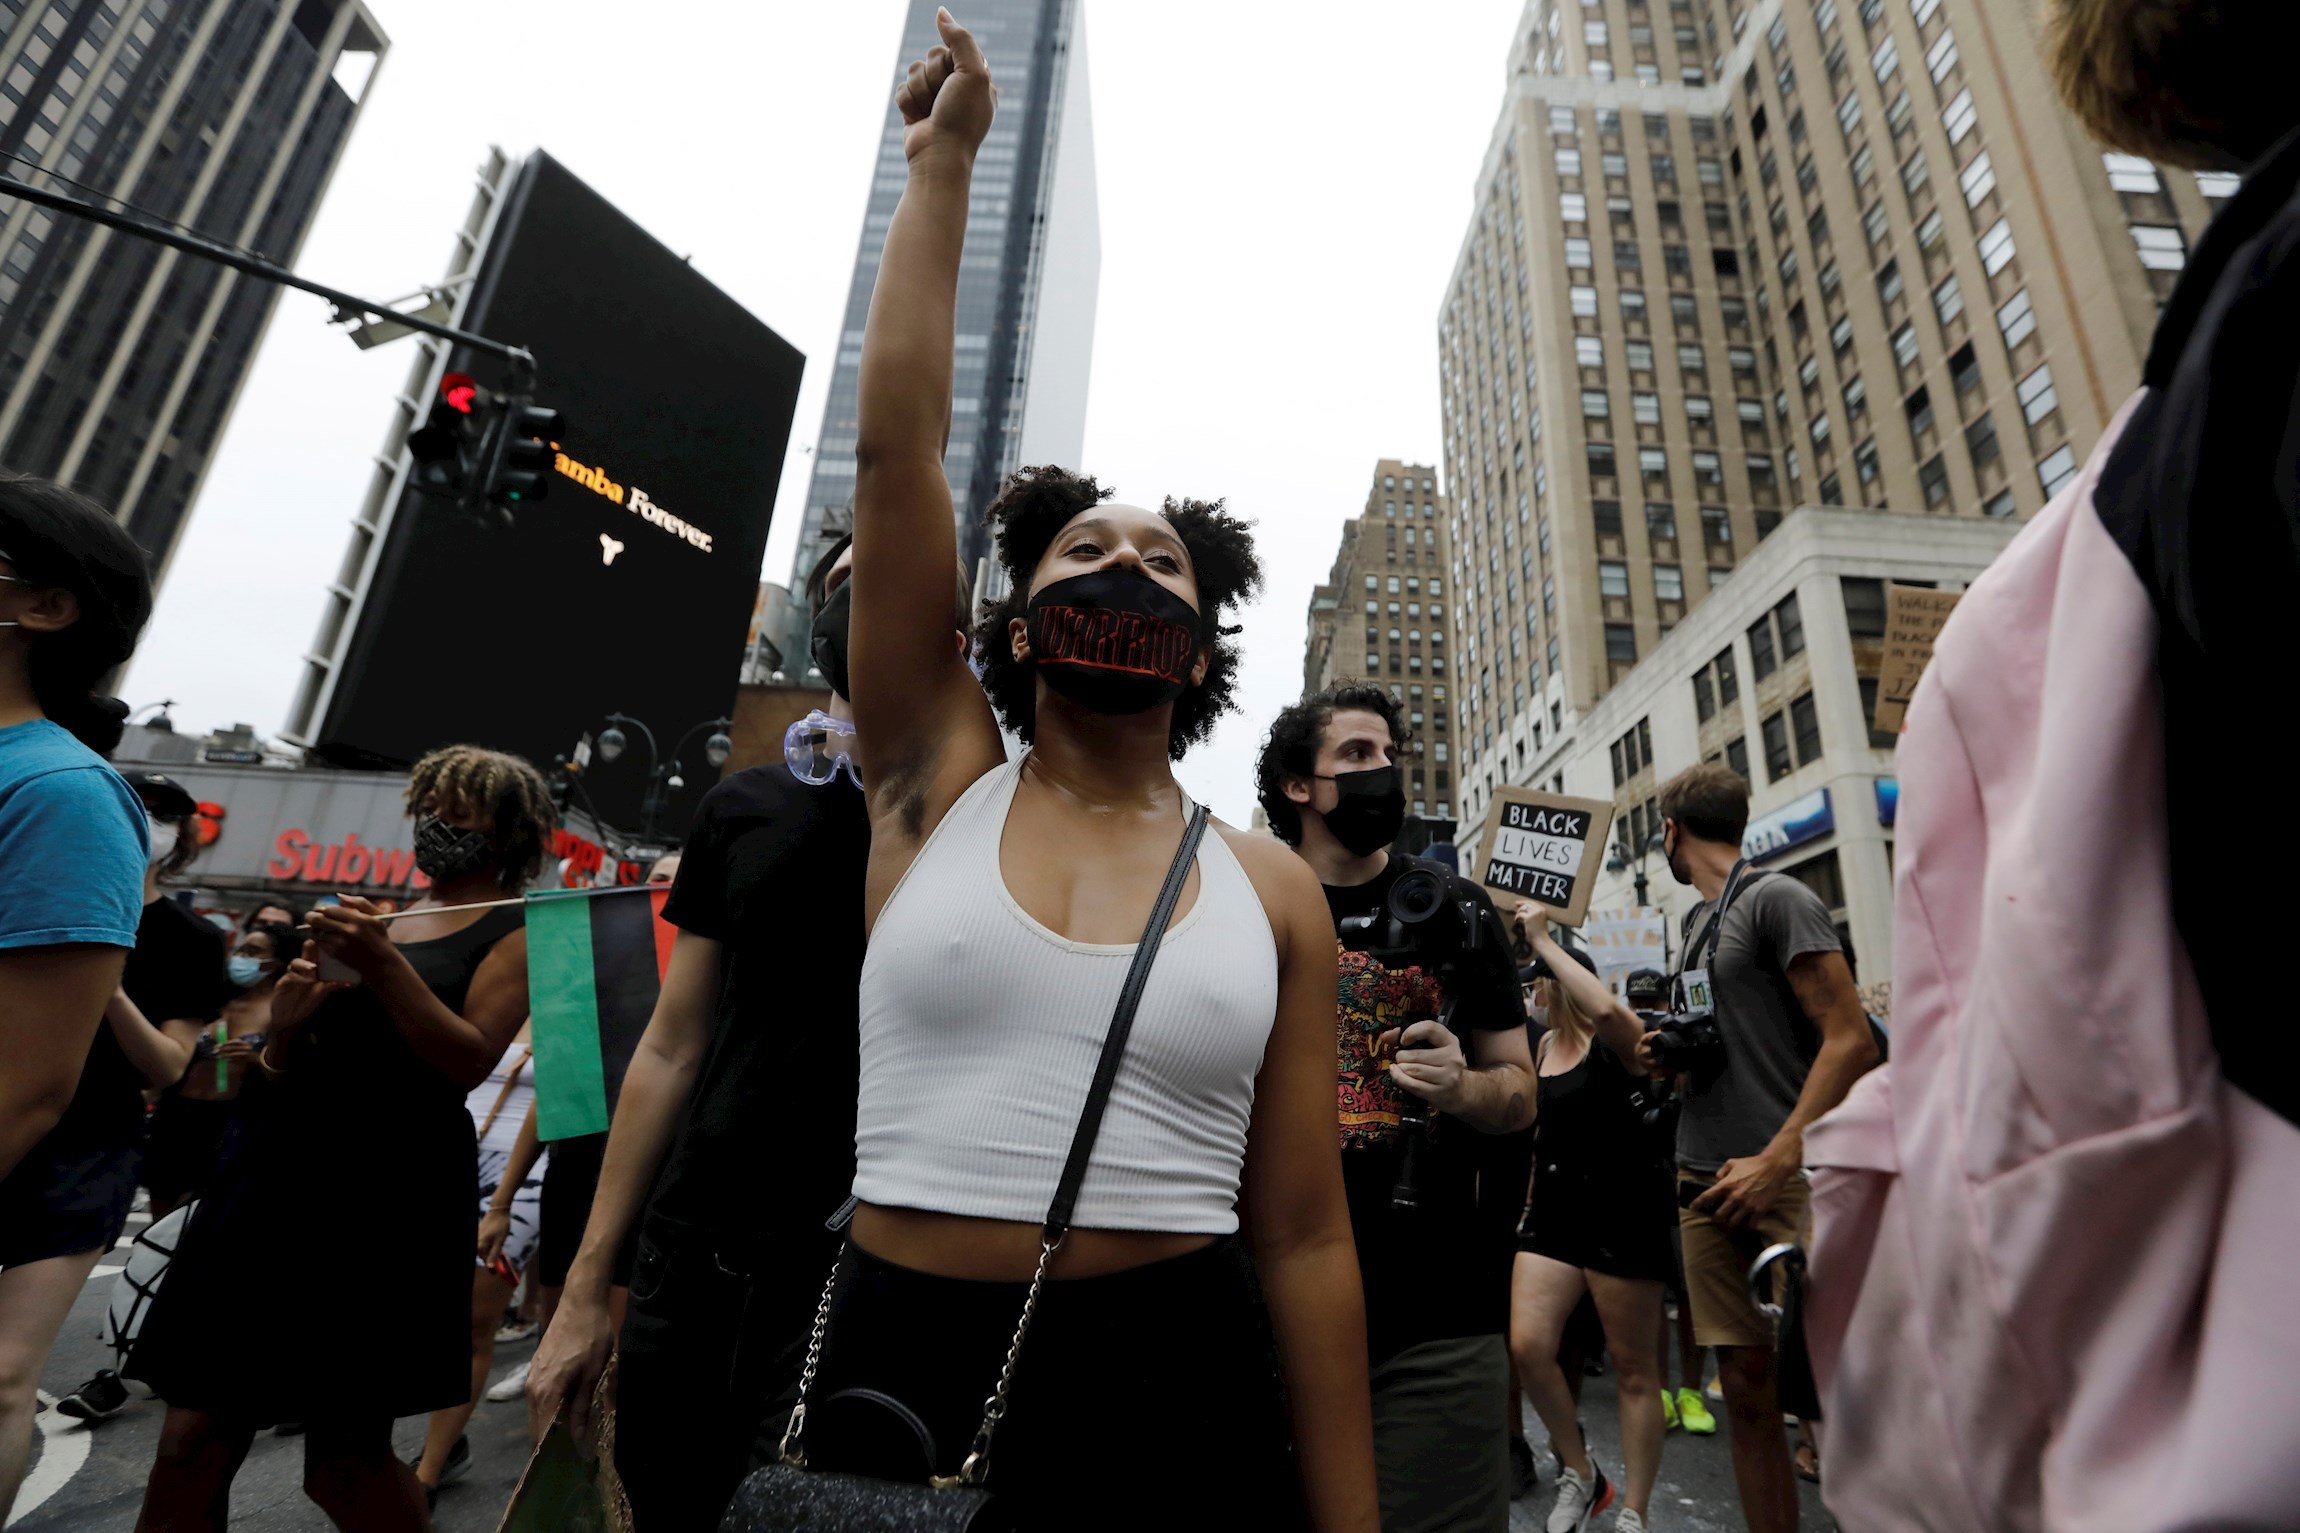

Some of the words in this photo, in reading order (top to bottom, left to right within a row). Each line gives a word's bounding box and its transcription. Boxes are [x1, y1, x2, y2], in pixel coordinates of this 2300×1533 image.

[550, 442, 625, 505] amba
[626, 486, 713, 553] Forever.
[1038, 606, 1192, 679] WARRIOR
[1509, 805, 1580, 835] BLACK
[1502, 833, 1571, 865] LIVES
[1488, 862, 1567, 899] MATTER
[1356, 1112, 1384, 1123] CHECK
